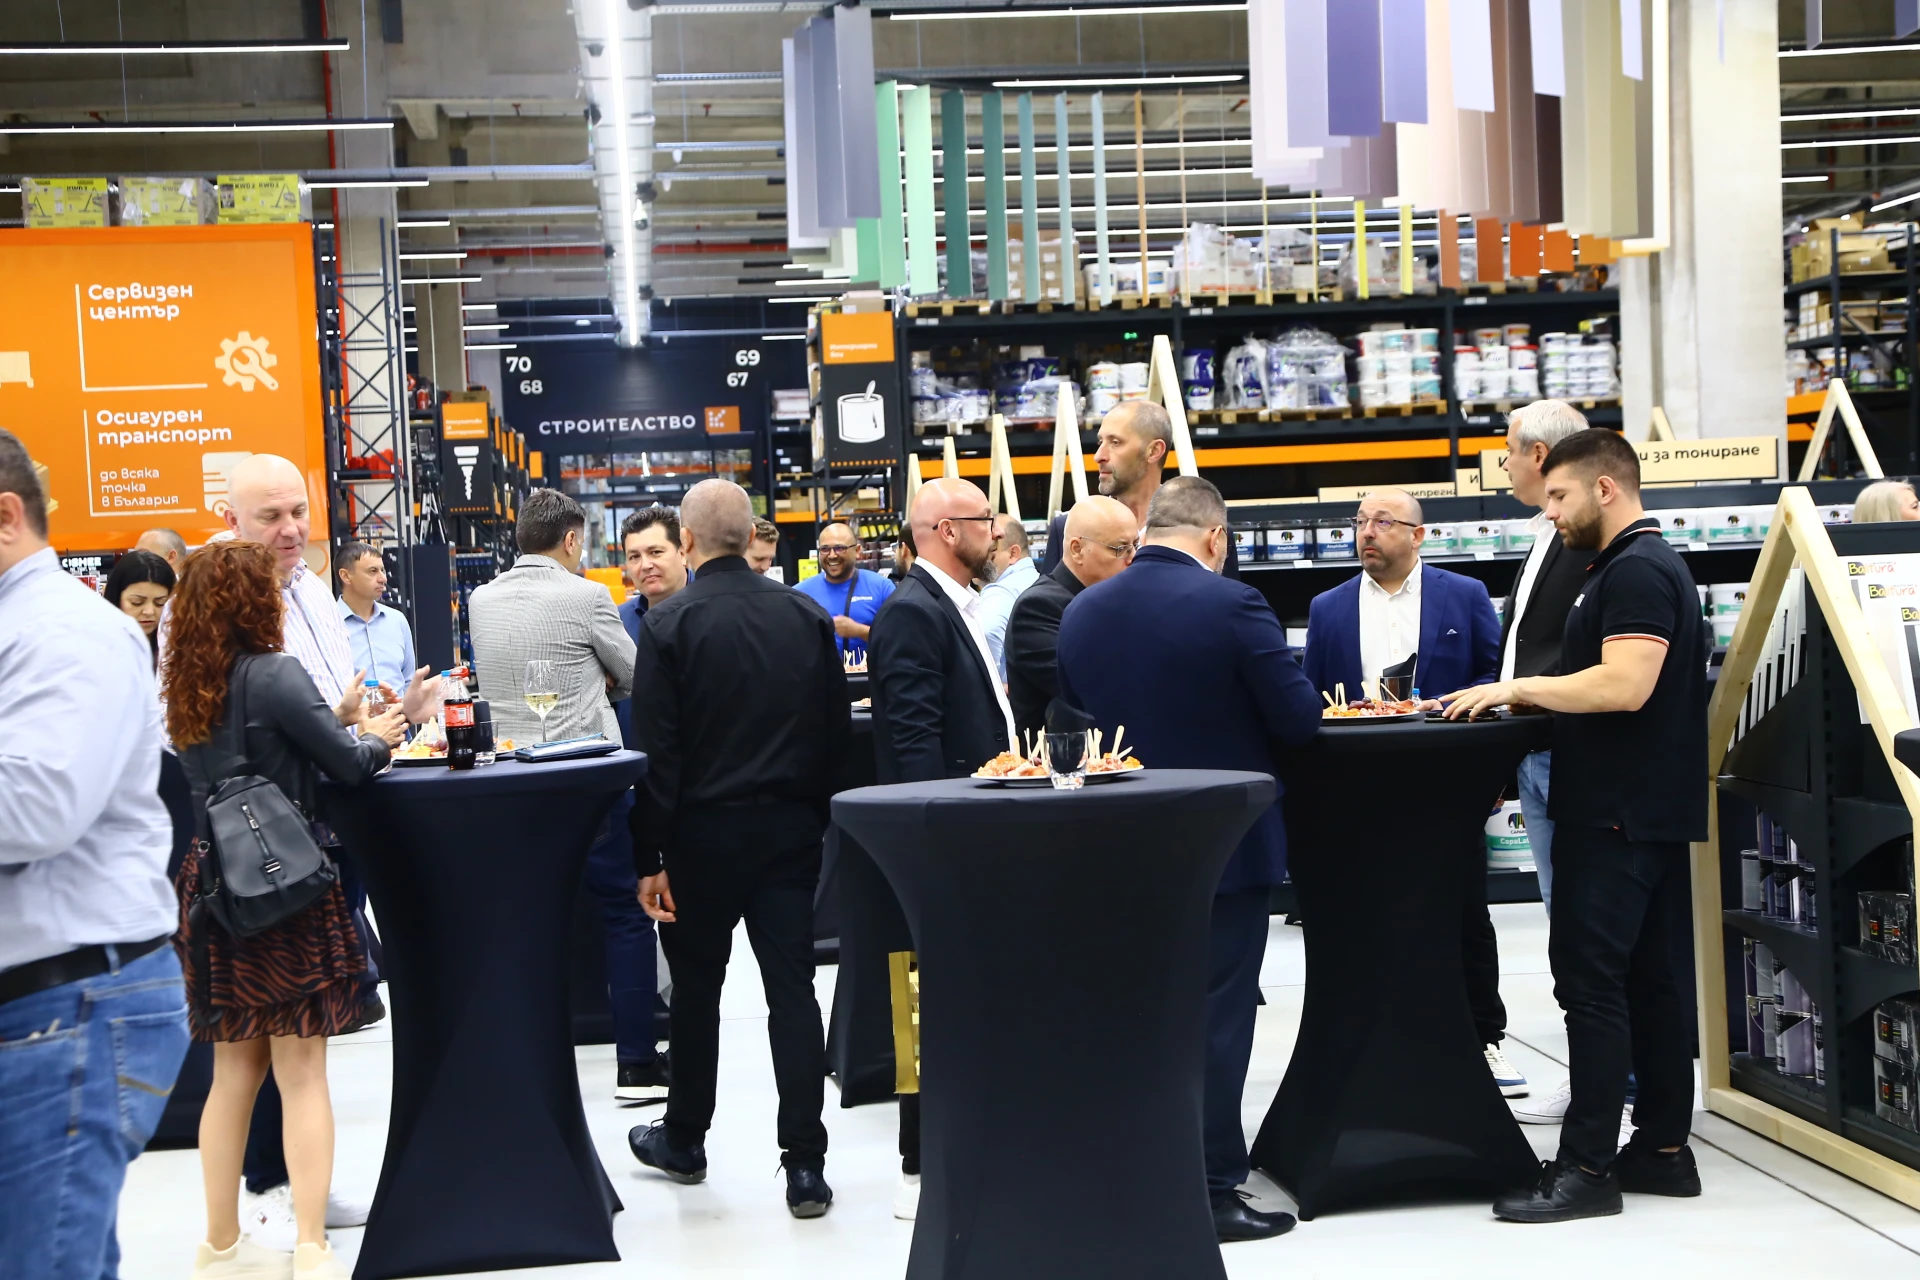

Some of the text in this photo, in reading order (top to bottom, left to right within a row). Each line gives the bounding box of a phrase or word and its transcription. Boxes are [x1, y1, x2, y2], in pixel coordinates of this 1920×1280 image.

[88, 282, 193, 303] Сервизен
[89, 304, 180, 321] център
[506, 356, 532, 373] 70
[735, 350, 761, 366] 69
[519, 380, 543, 395] 68
[726, 372, 749, 387] 67
[96, 409, 203, 427] Осигурен
[538, 414, 696, 435] СТРОИТЕЛСТВО
[98, 427, 232, 448] транспорт
[1653, 451, 1670, 463] за
[1675, 446, 1761, 460] тониране
[100, 467, 160, 482] до всяка
[101, 481, 146, 494] точка
[101, 495, 179, 508] в България
[1501, 837, 1530, 845] CapaLat
